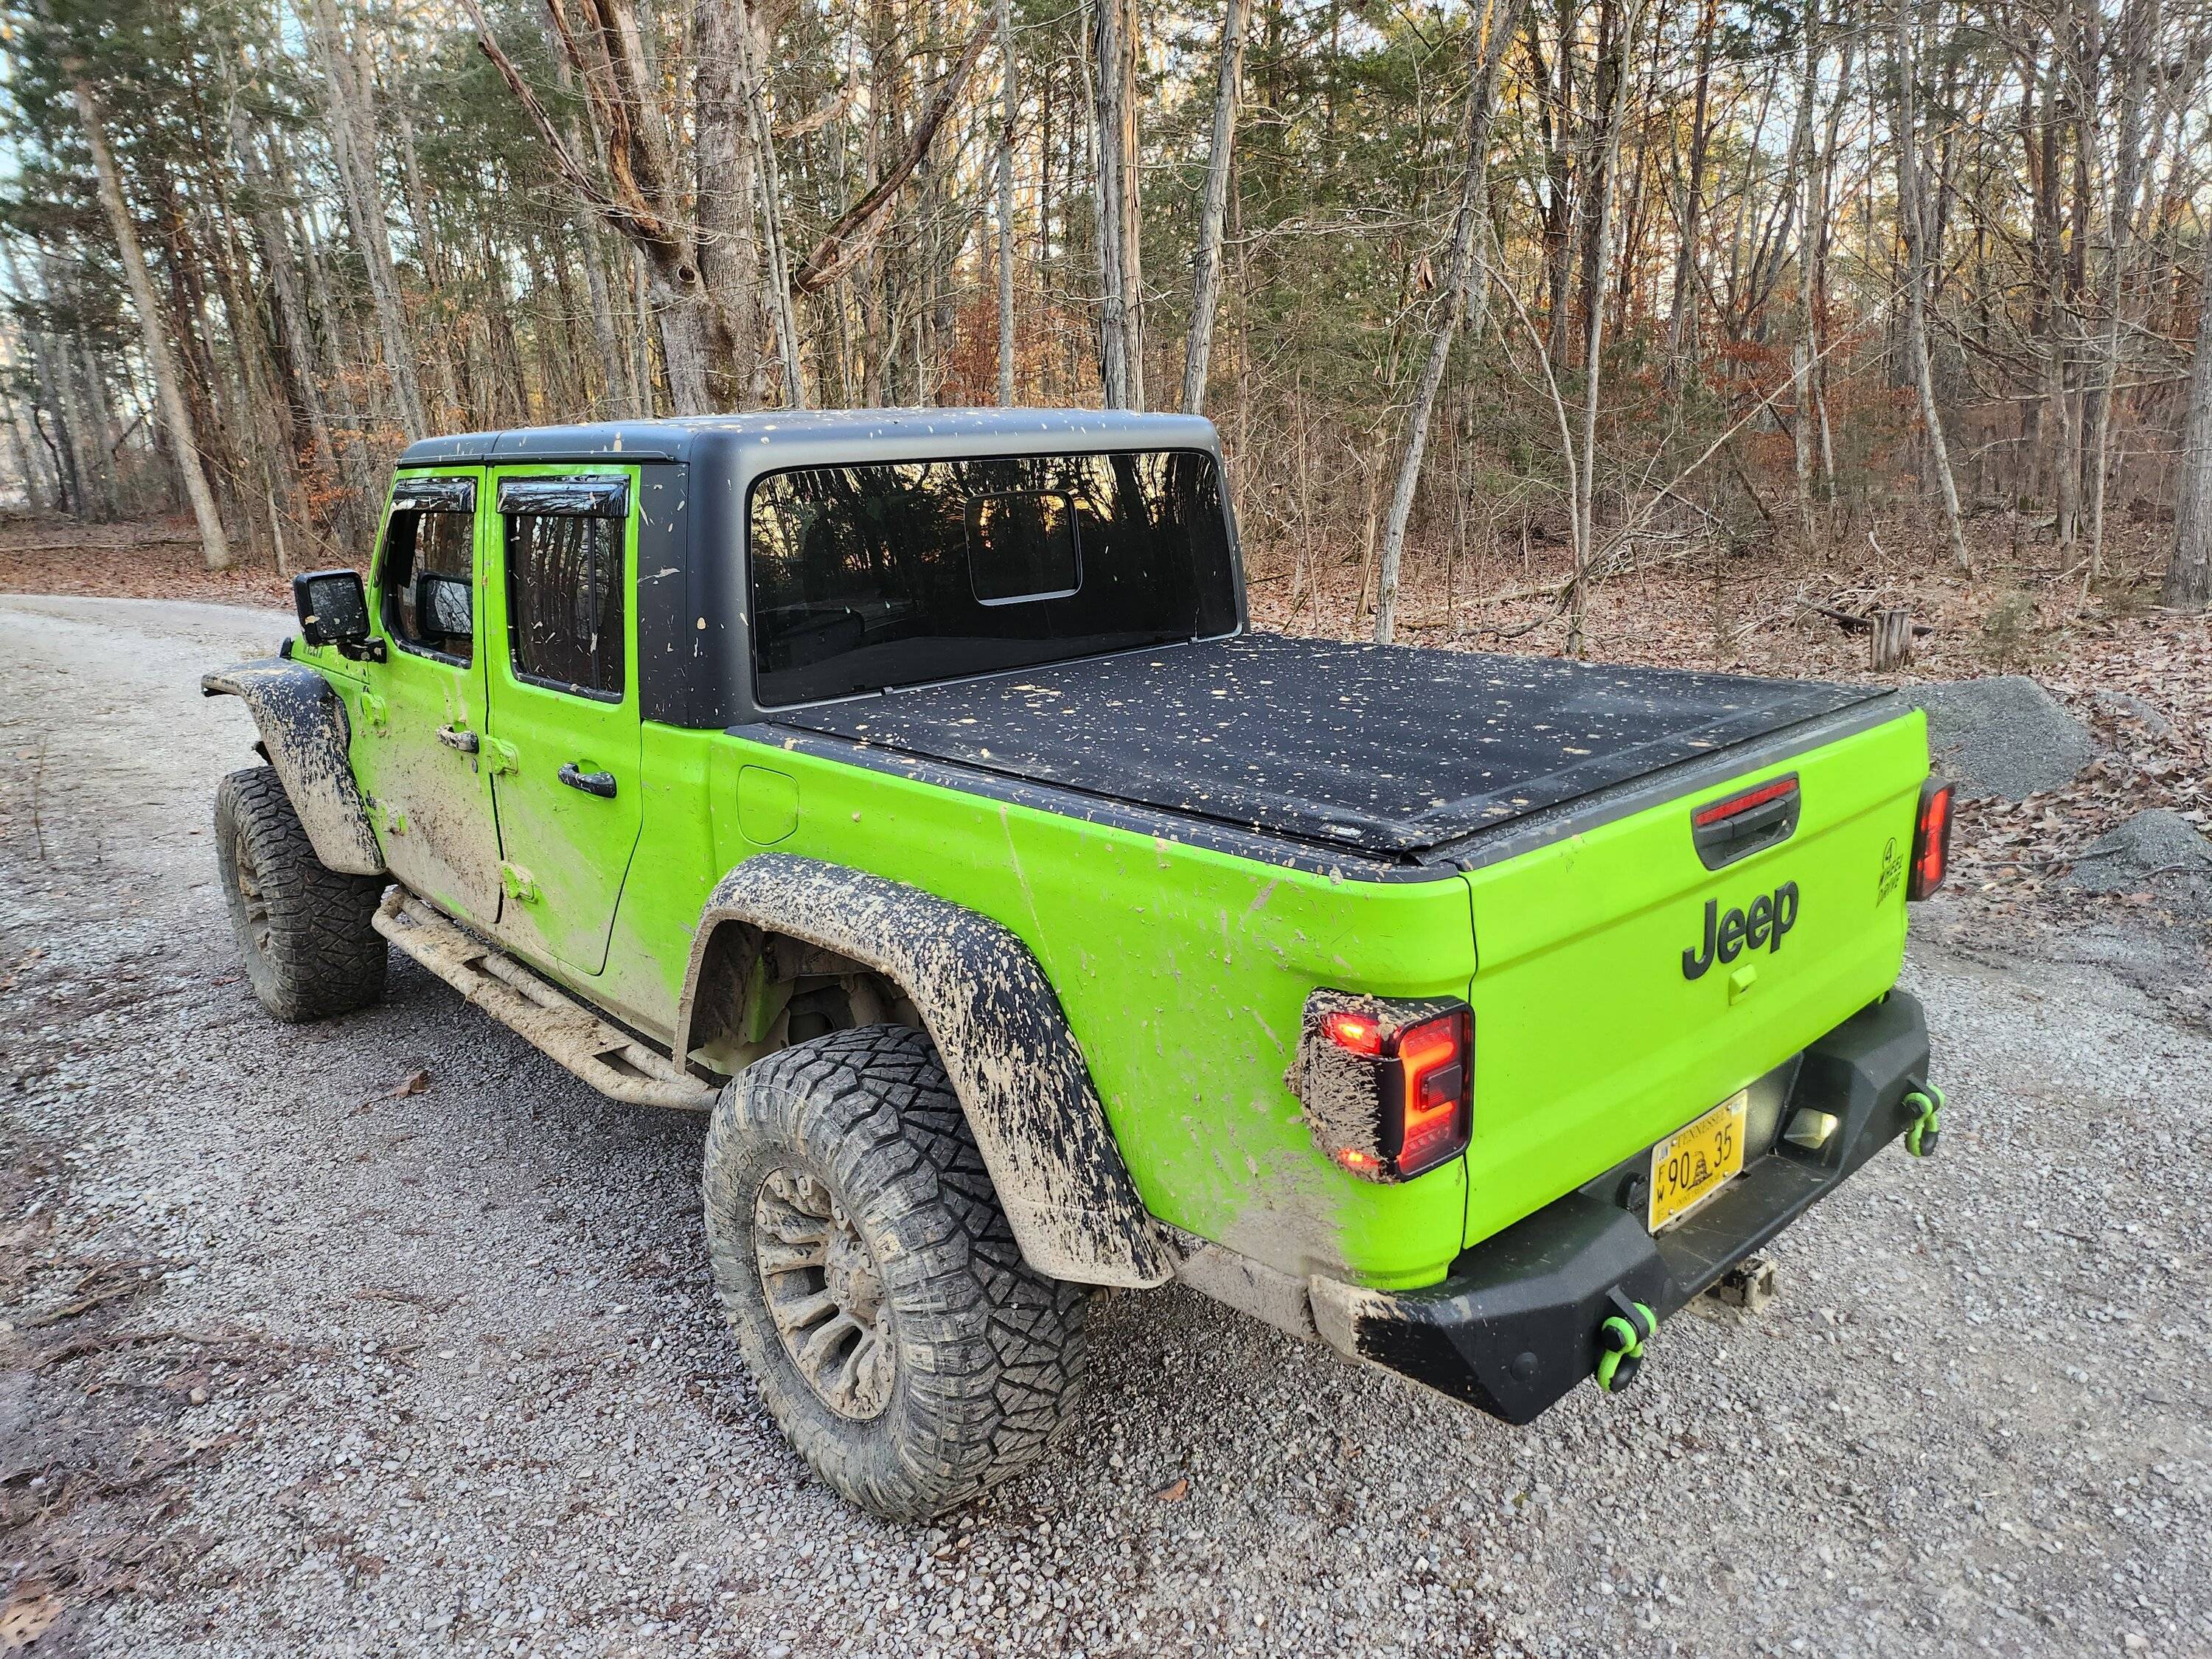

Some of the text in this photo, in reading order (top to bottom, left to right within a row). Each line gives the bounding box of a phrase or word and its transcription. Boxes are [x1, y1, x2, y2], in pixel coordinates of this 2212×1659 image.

[1683, 880, 1799, 981] Jeep
[1669, 1151, 1690, 1195] 90
[1714, 1123, 1732, 1168] 35
[1676, 1108, 1726, 1148] TENNESSEE
